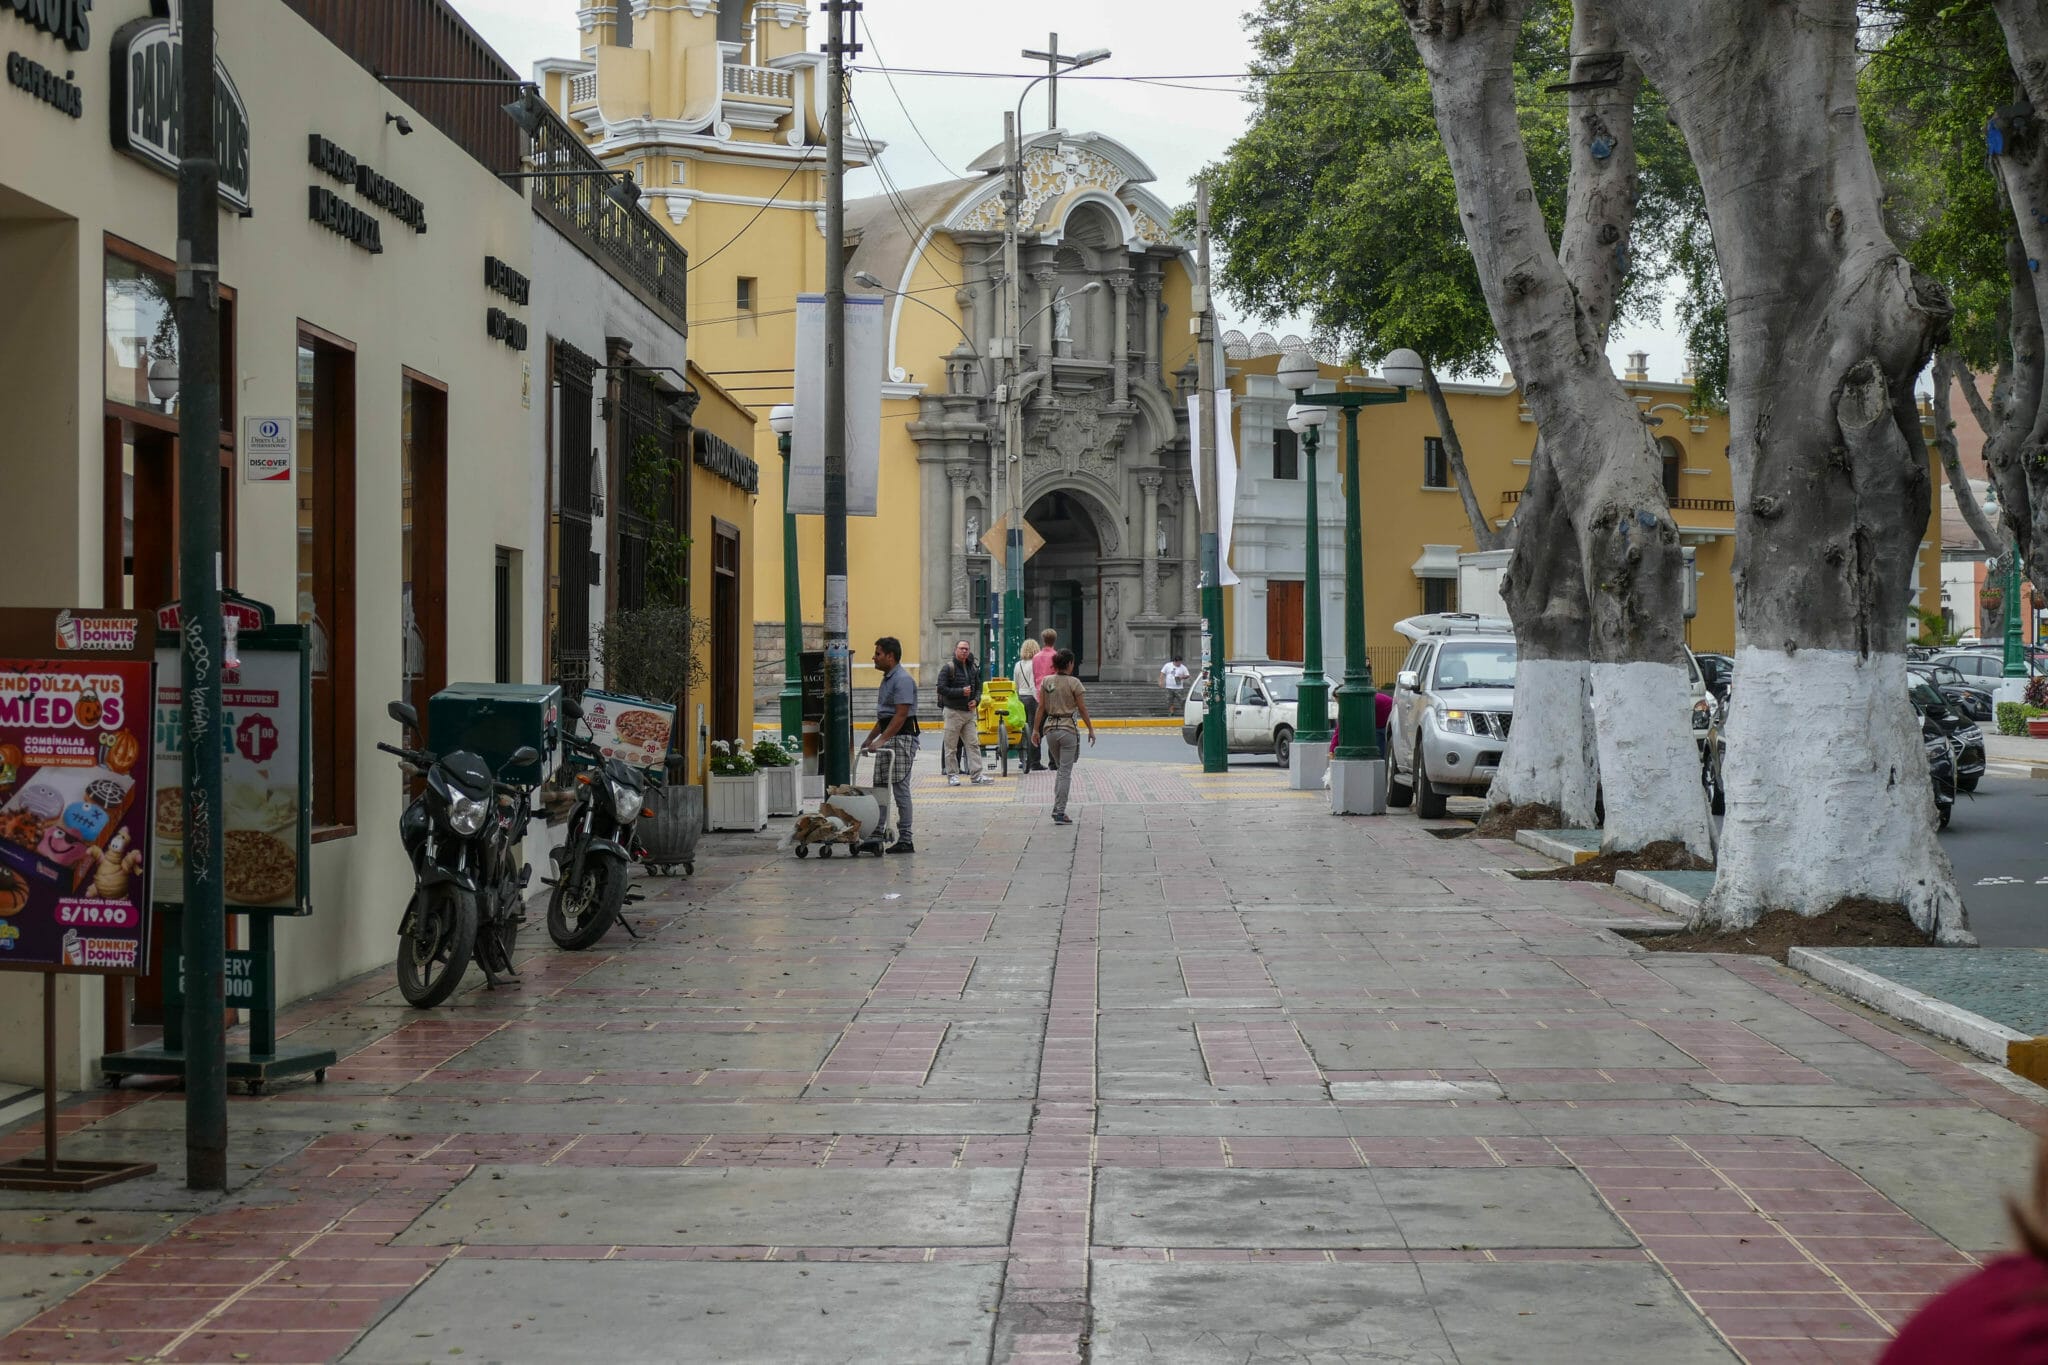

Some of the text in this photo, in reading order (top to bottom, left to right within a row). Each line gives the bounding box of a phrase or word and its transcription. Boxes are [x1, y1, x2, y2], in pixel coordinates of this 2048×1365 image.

[311, 135, 357, 184] MEJORES
[311, 187, 352, 238] MEJOR
[486, 256, 530, 305] DELIVERY
[83, 620, 136, 630] DUNKIN'
[83, 631, 134, 641] DONUTS
[90, 680, 120, 693] TUS
[24, 745, 95, 755] COMO QUIERAS
[646, 744, 656, 753] 39
[88, 951, 134, 961] DONUTS
